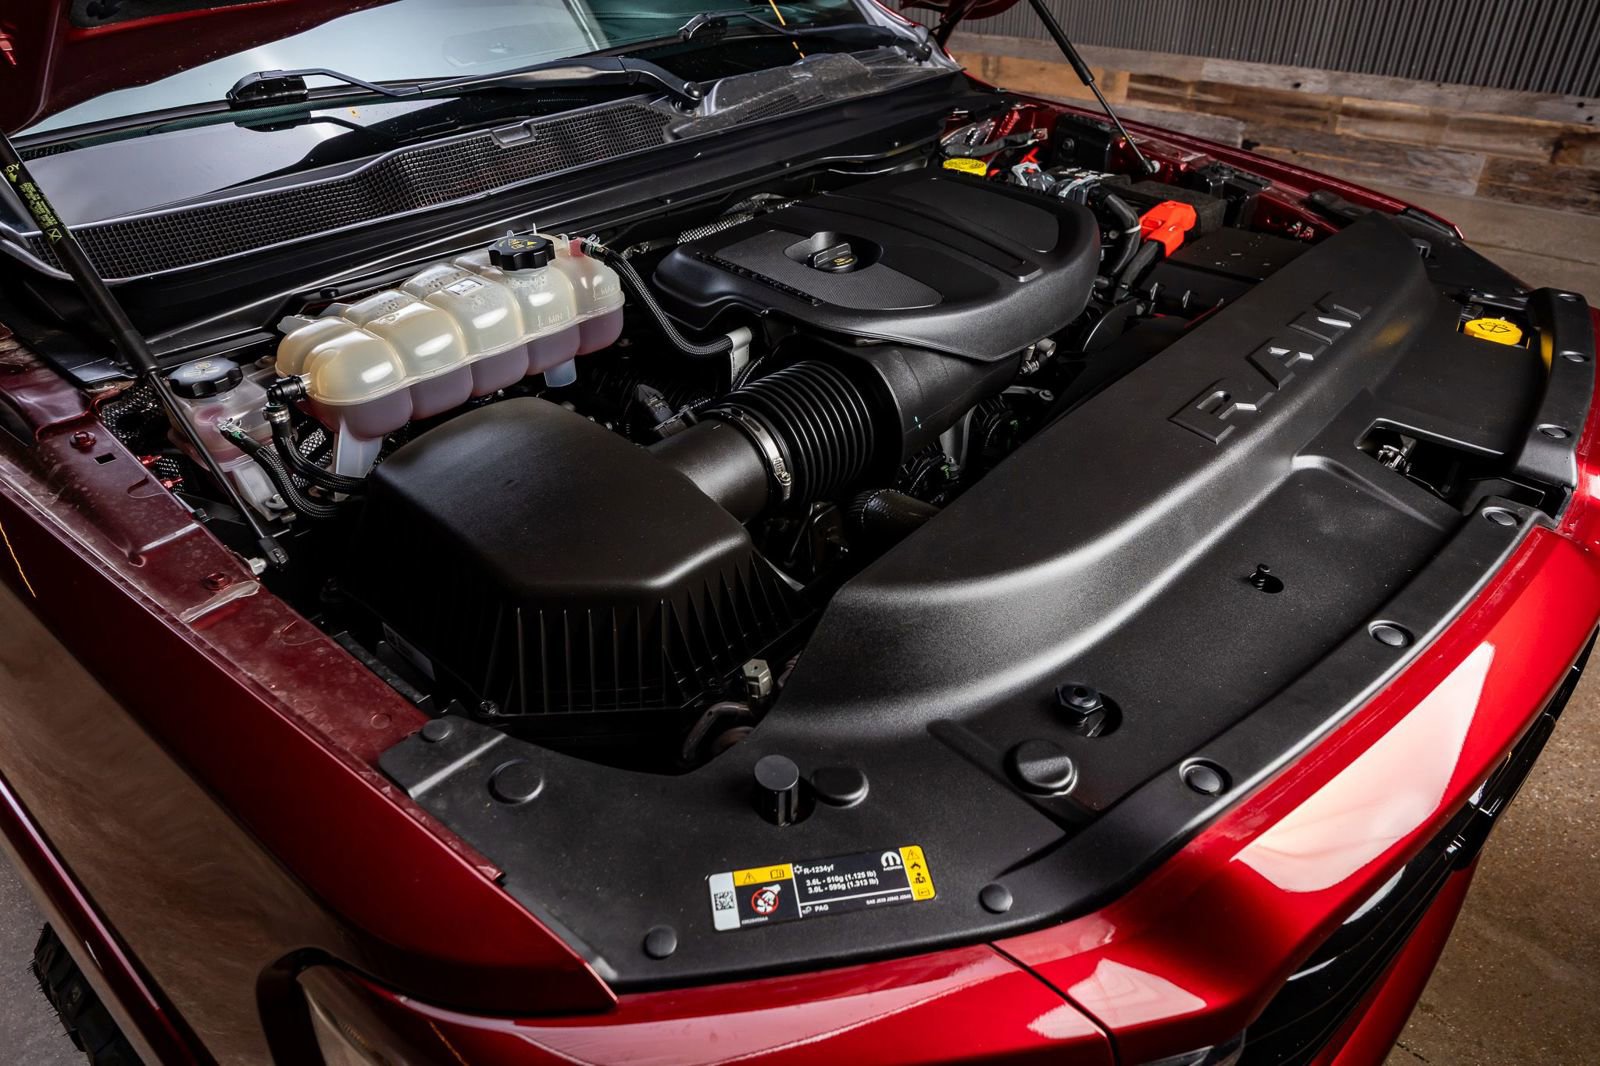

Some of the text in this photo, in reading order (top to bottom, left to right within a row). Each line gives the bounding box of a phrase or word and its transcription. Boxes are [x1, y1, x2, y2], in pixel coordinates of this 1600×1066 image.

[548, 312, 563, 324] MIN
[1167, 291, 1372, 445] RAM
[803, 864, 834, 875] R-1234yf
[814, 904, 829, 912] PAG
